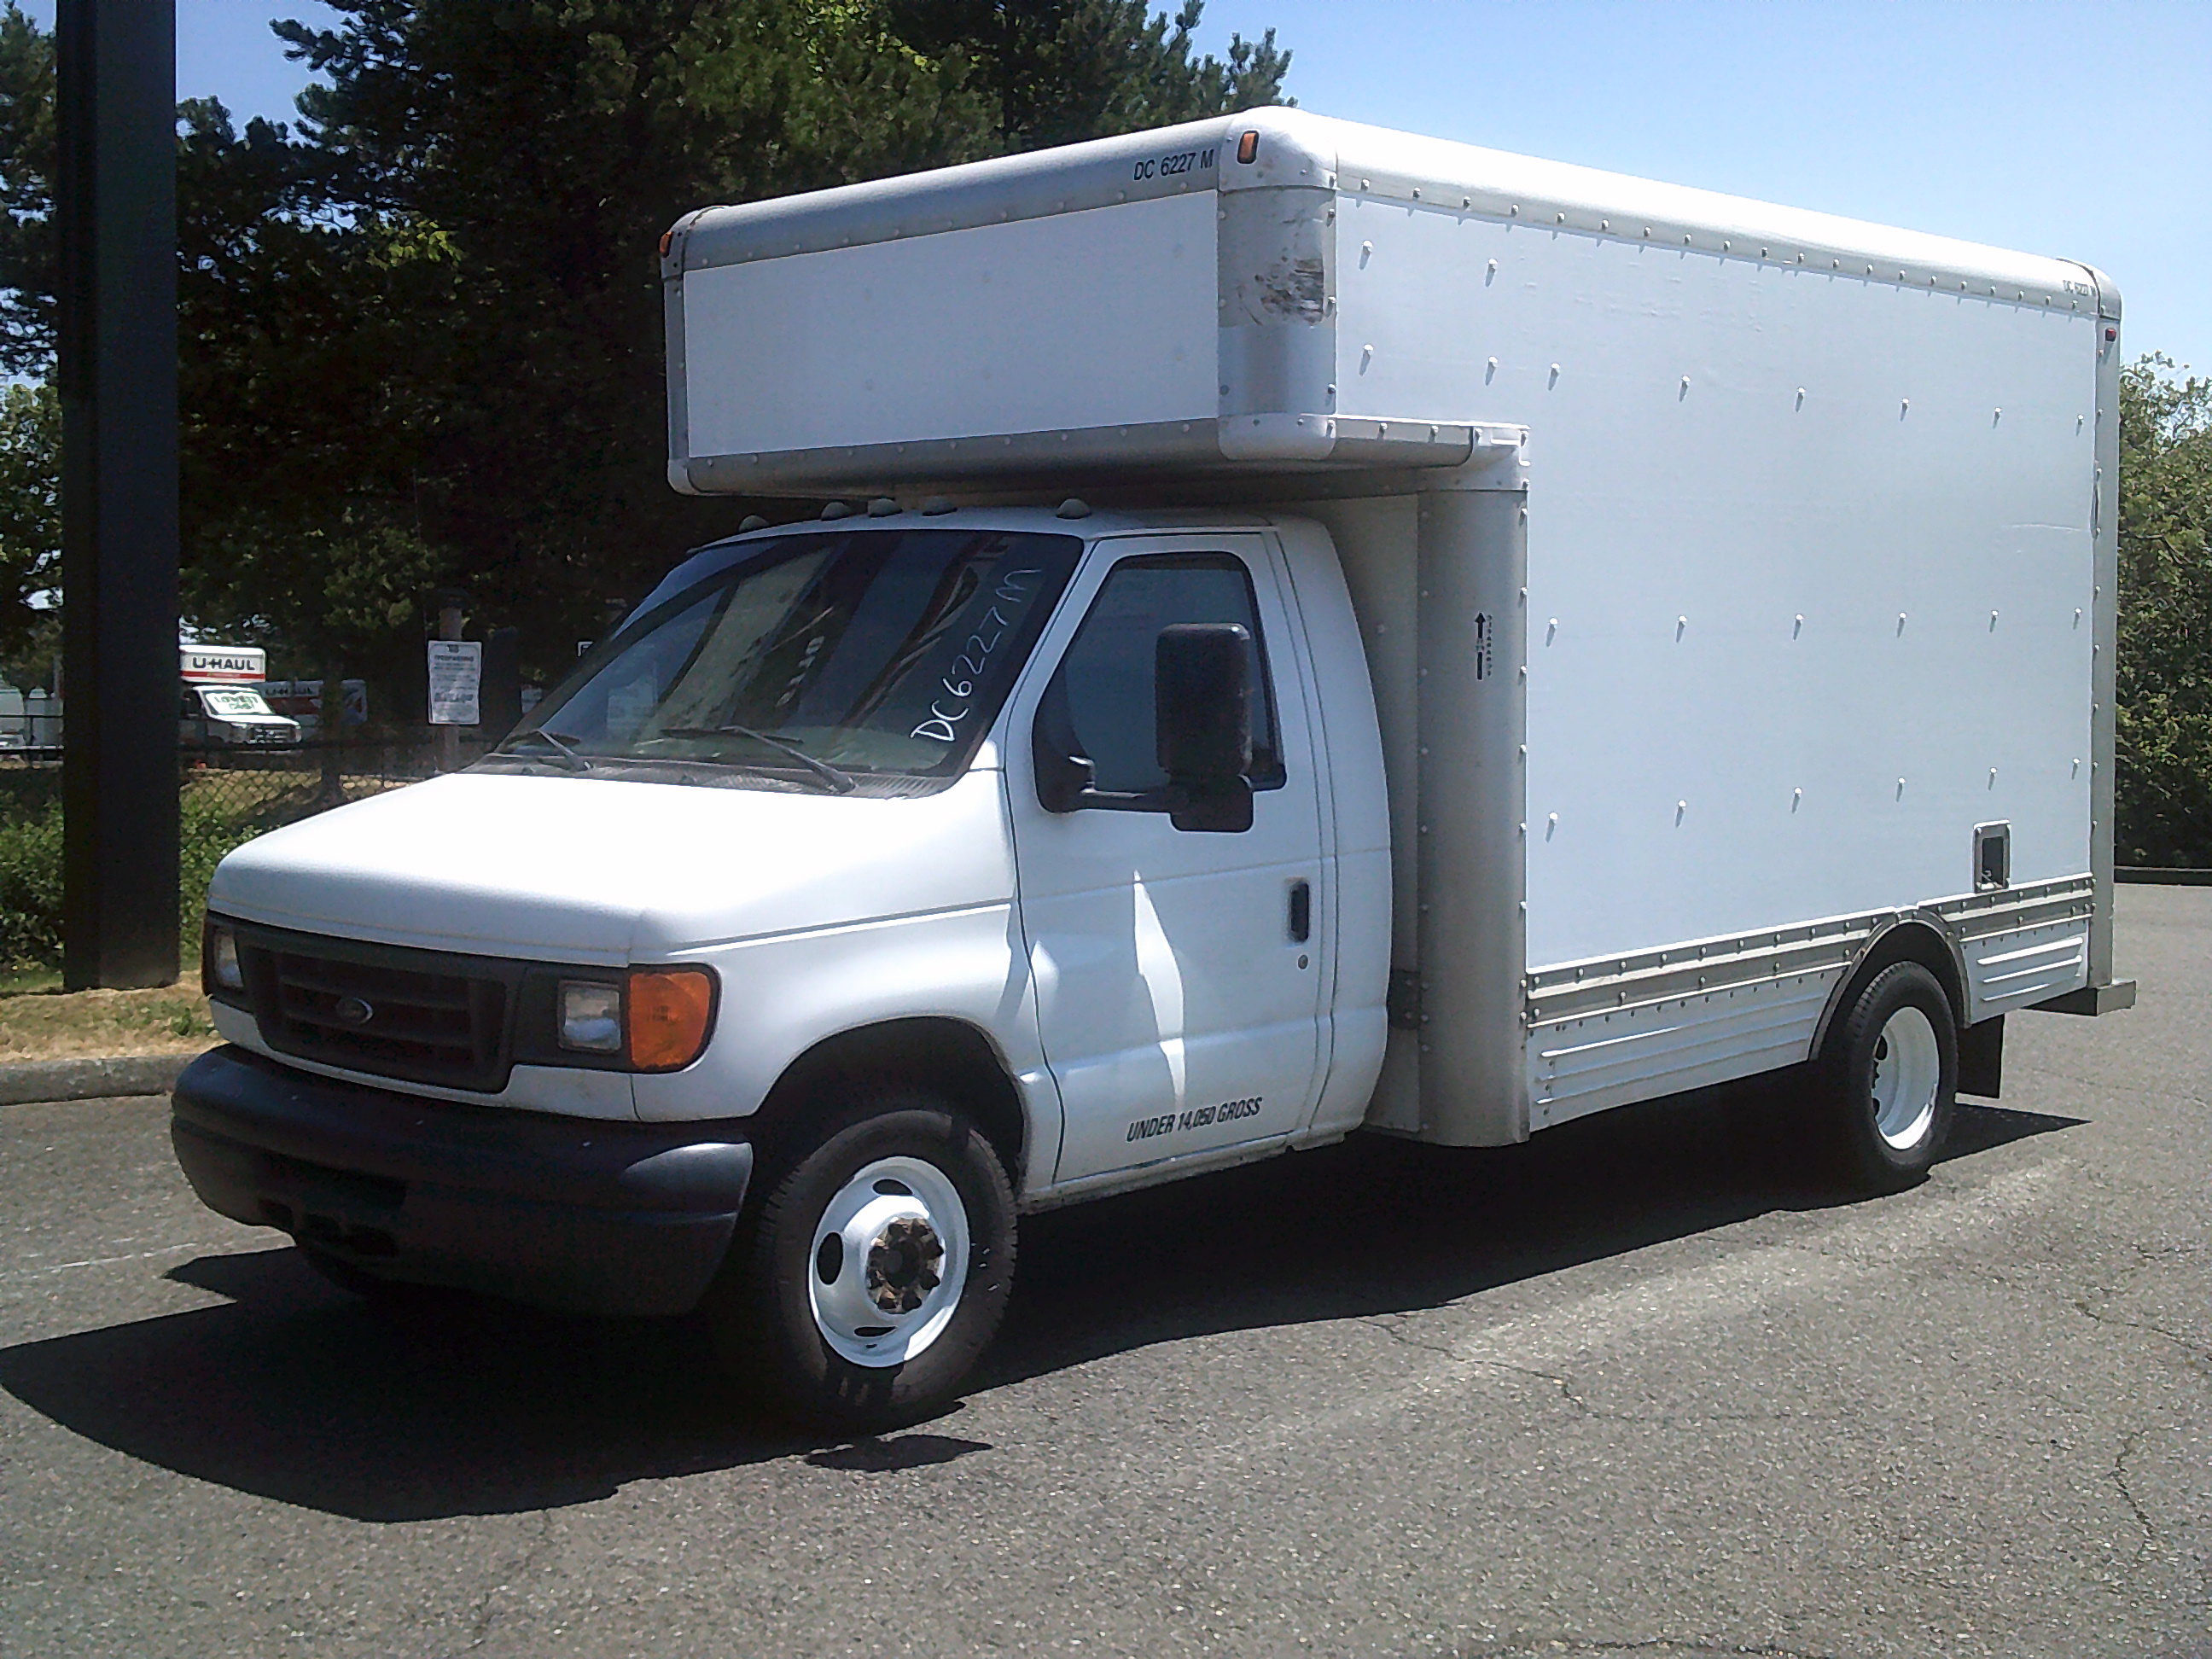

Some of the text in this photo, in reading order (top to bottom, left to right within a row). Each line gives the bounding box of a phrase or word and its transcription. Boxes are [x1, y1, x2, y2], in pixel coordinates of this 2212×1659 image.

[1133, 148, 1214, 181] DC 6227 M
[192, 656, 256, 671] U-HAUL
[1126, 1097, 1263, 1142] UNDER 14,050 GROSS
